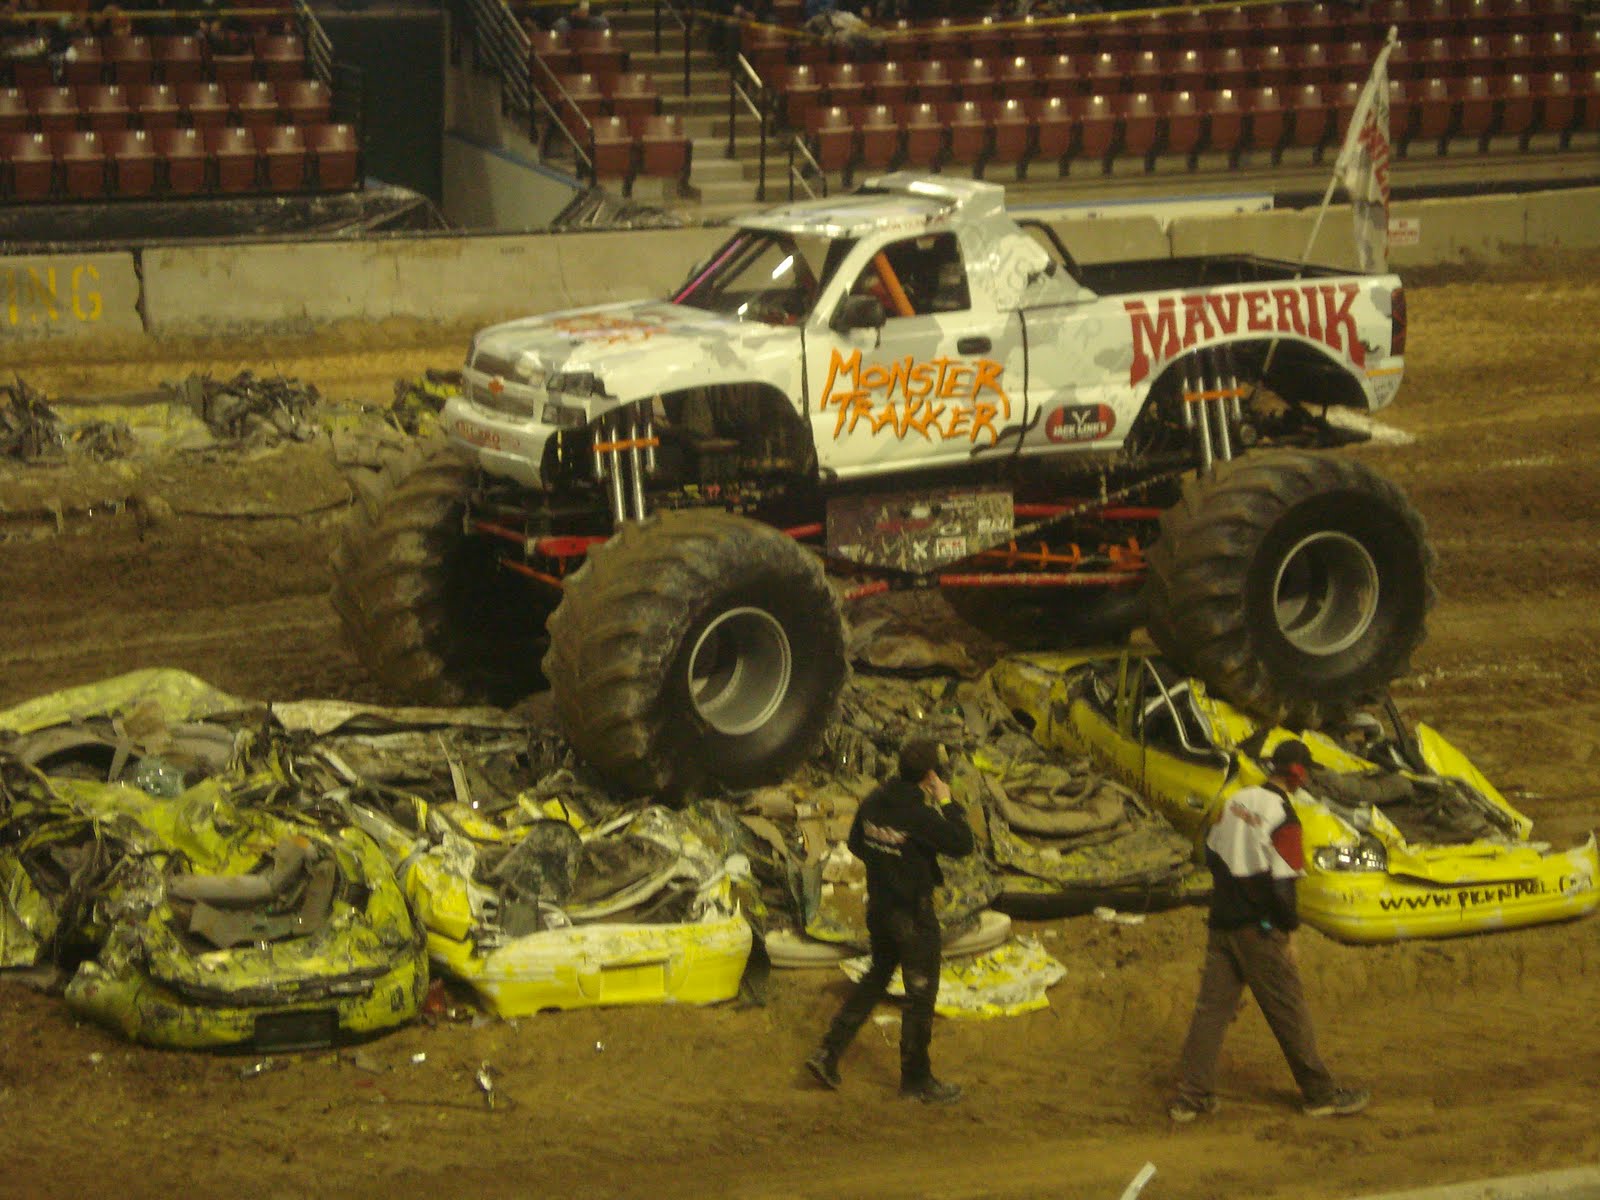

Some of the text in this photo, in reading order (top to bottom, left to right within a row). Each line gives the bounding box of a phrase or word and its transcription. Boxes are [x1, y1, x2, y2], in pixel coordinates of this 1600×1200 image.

[1123, 283, 1366, 388] MAVERIK
[820, 347, 1011, 420] MONSTER
[830, 390, 999, 448] TRAKKER
